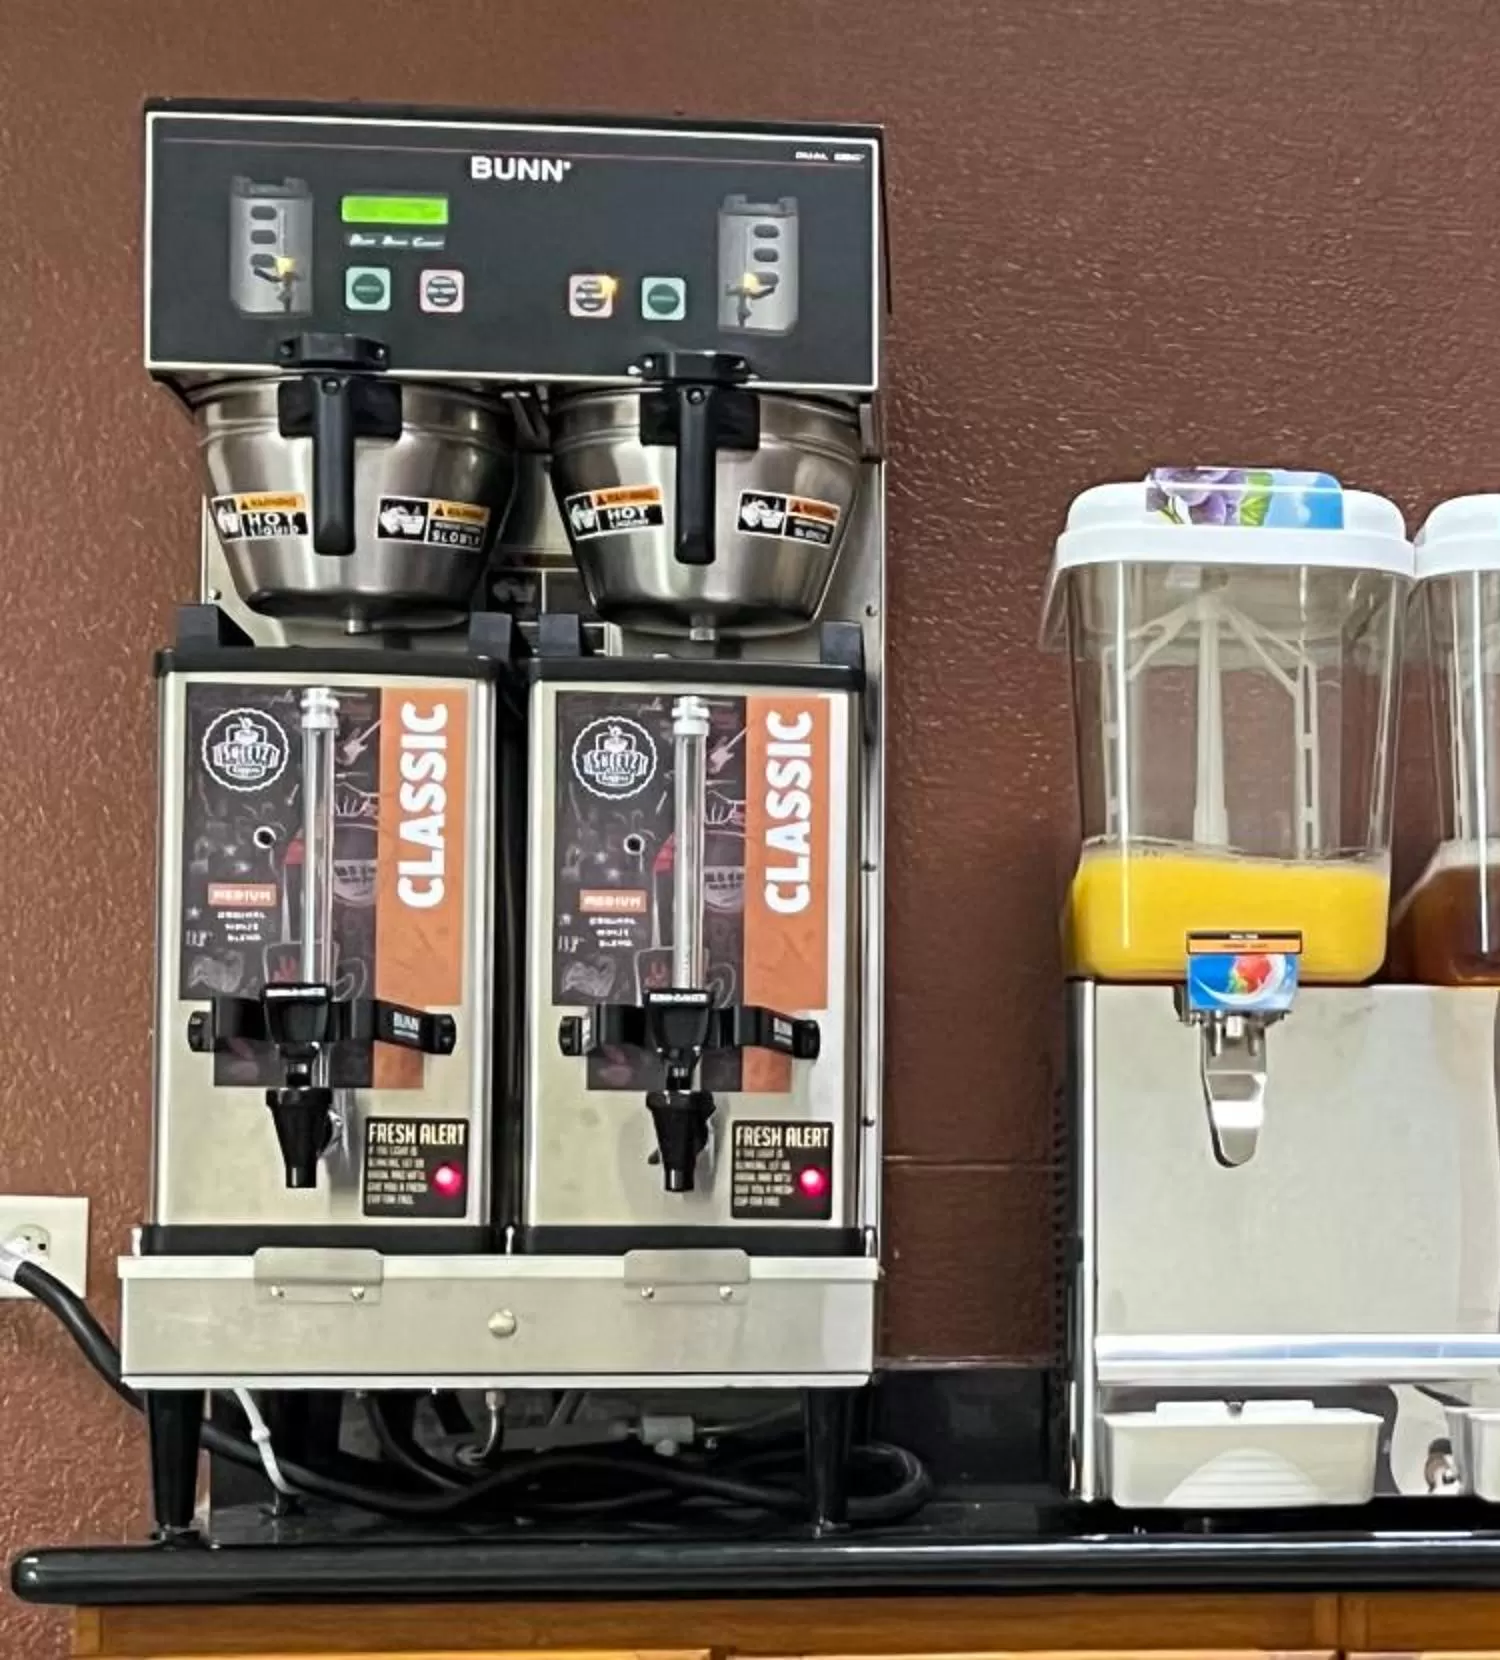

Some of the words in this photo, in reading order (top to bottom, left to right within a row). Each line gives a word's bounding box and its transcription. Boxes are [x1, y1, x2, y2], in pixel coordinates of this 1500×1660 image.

[397, 702, 449, 908] CLASSIC
[764, 711, 813, 913] CLASSIC
[369, 1123, 417, 1145] FRESH
[420, 1123, 465, 1145] ALERT
[736, 1126, 782, 1147] FRESH
[786, 1127, 830, 1148] ALERT
